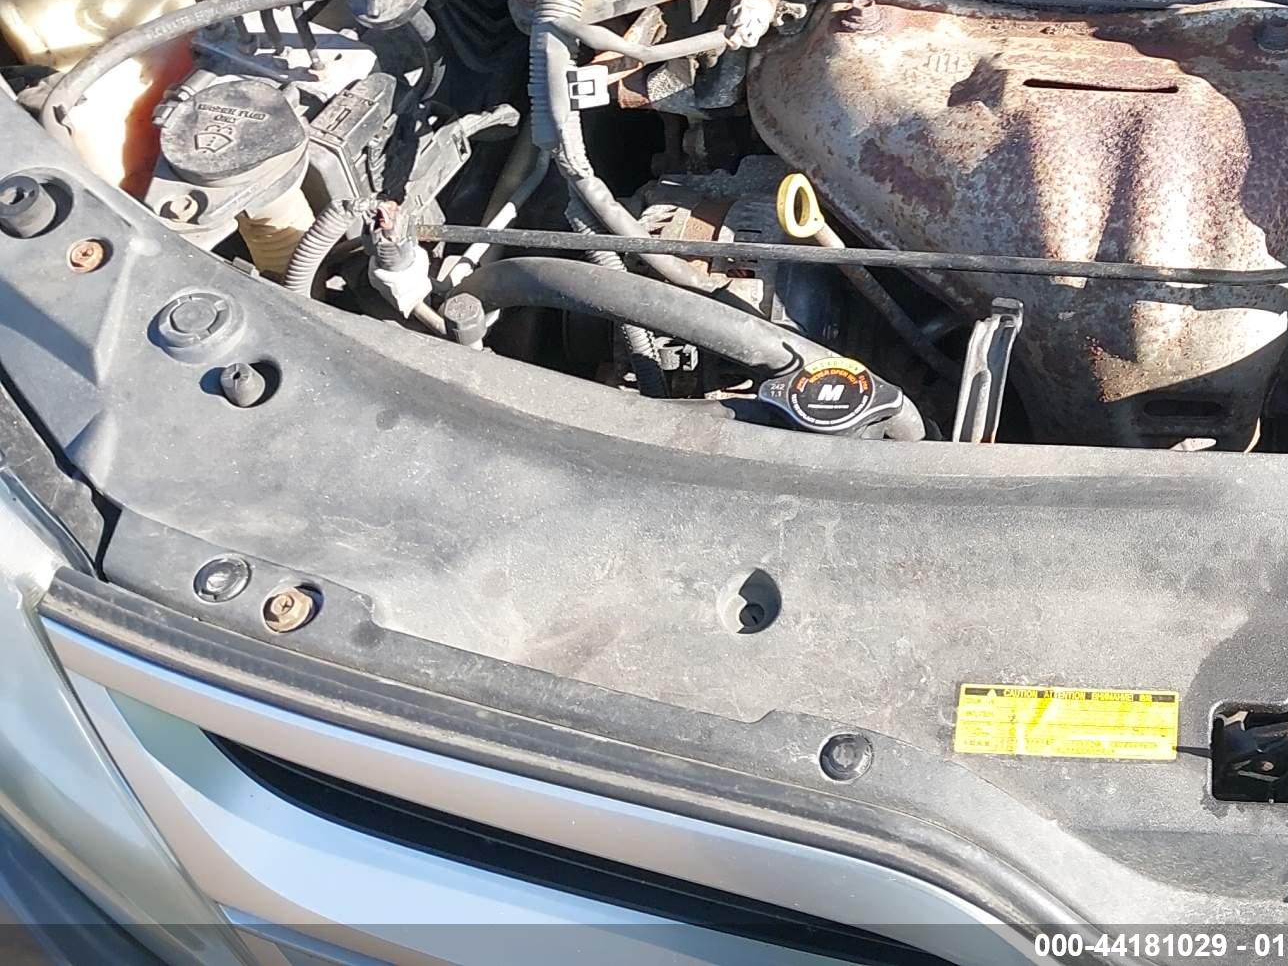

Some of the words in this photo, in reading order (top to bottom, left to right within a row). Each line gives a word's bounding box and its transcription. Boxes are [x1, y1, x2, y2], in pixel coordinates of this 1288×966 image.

[817, 384, 845, 401] M
[1003, 689, 1037, 698] CAUTION
[1043, 689, 1086, 700] ATTENTION
